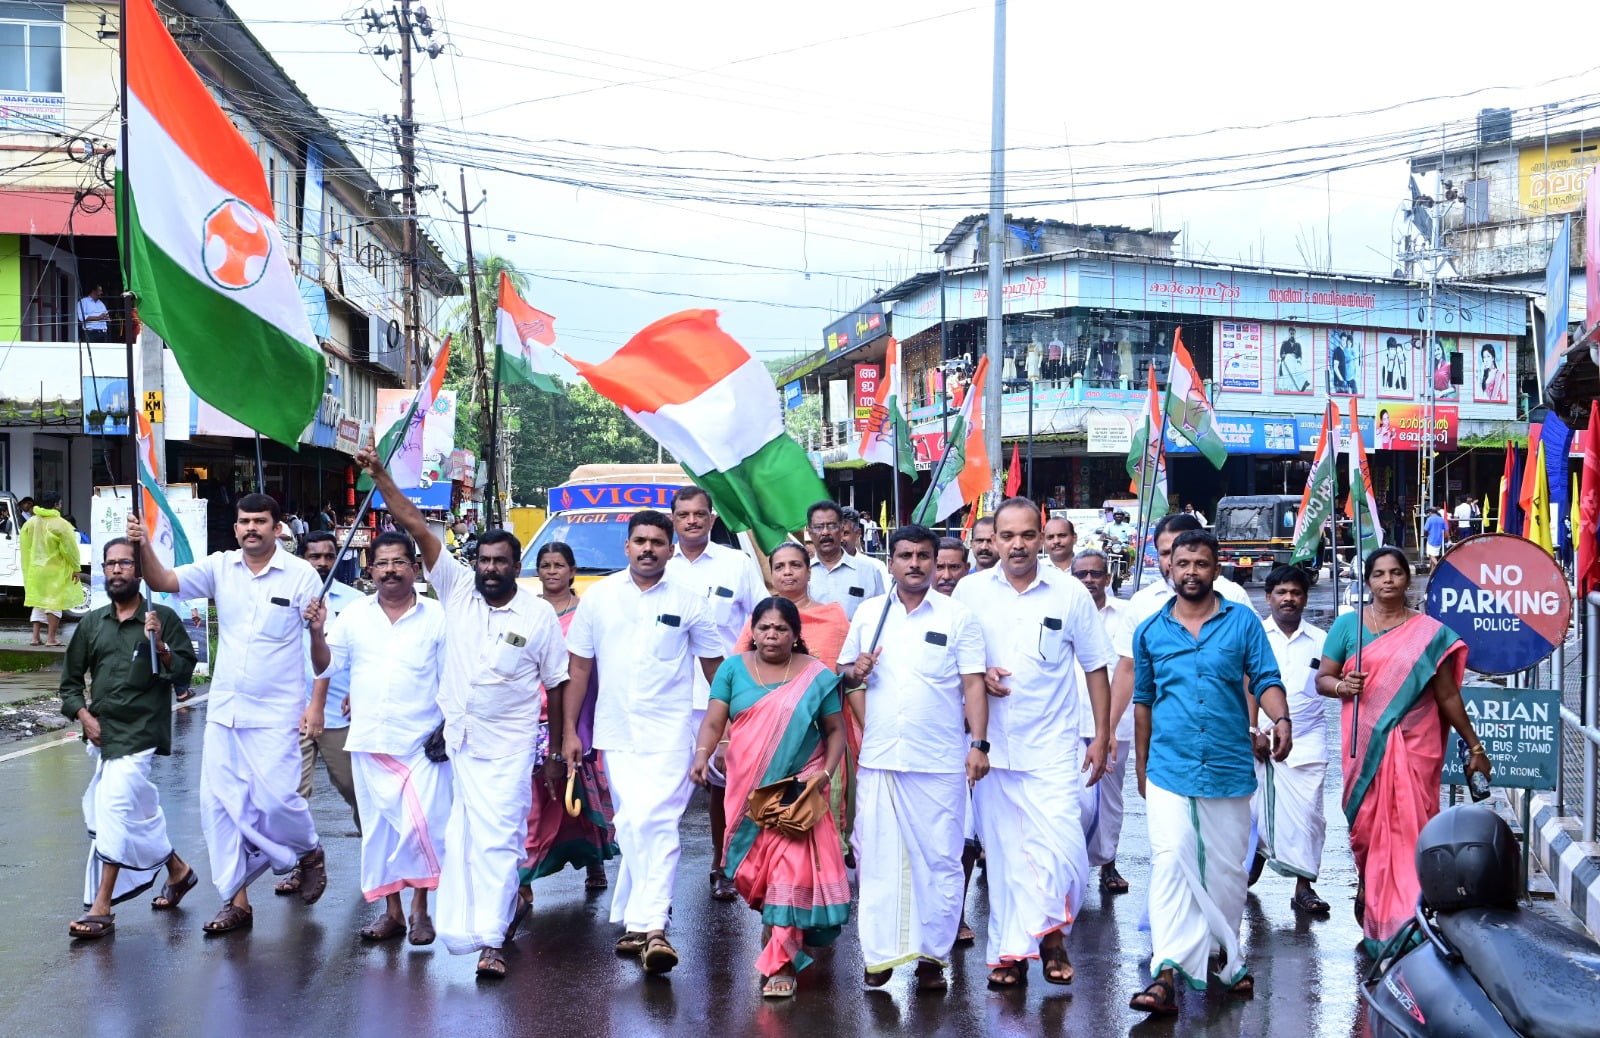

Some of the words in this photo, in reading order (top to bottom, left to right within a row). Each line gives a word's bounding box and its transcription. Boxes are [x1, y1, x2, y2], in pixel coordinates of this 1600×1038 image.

[145, 400, 161, 410] KM
[566, 513, 608, 524] VIGIL
[1480, 563, 1523, 586] NO
[1441, 587, 1560, 616] PARKING
[1473, 617, 1521, 632] POLICE
[1493, 740, 1513, 753] BUS
[1517, 742, 1552, 754] STAND
